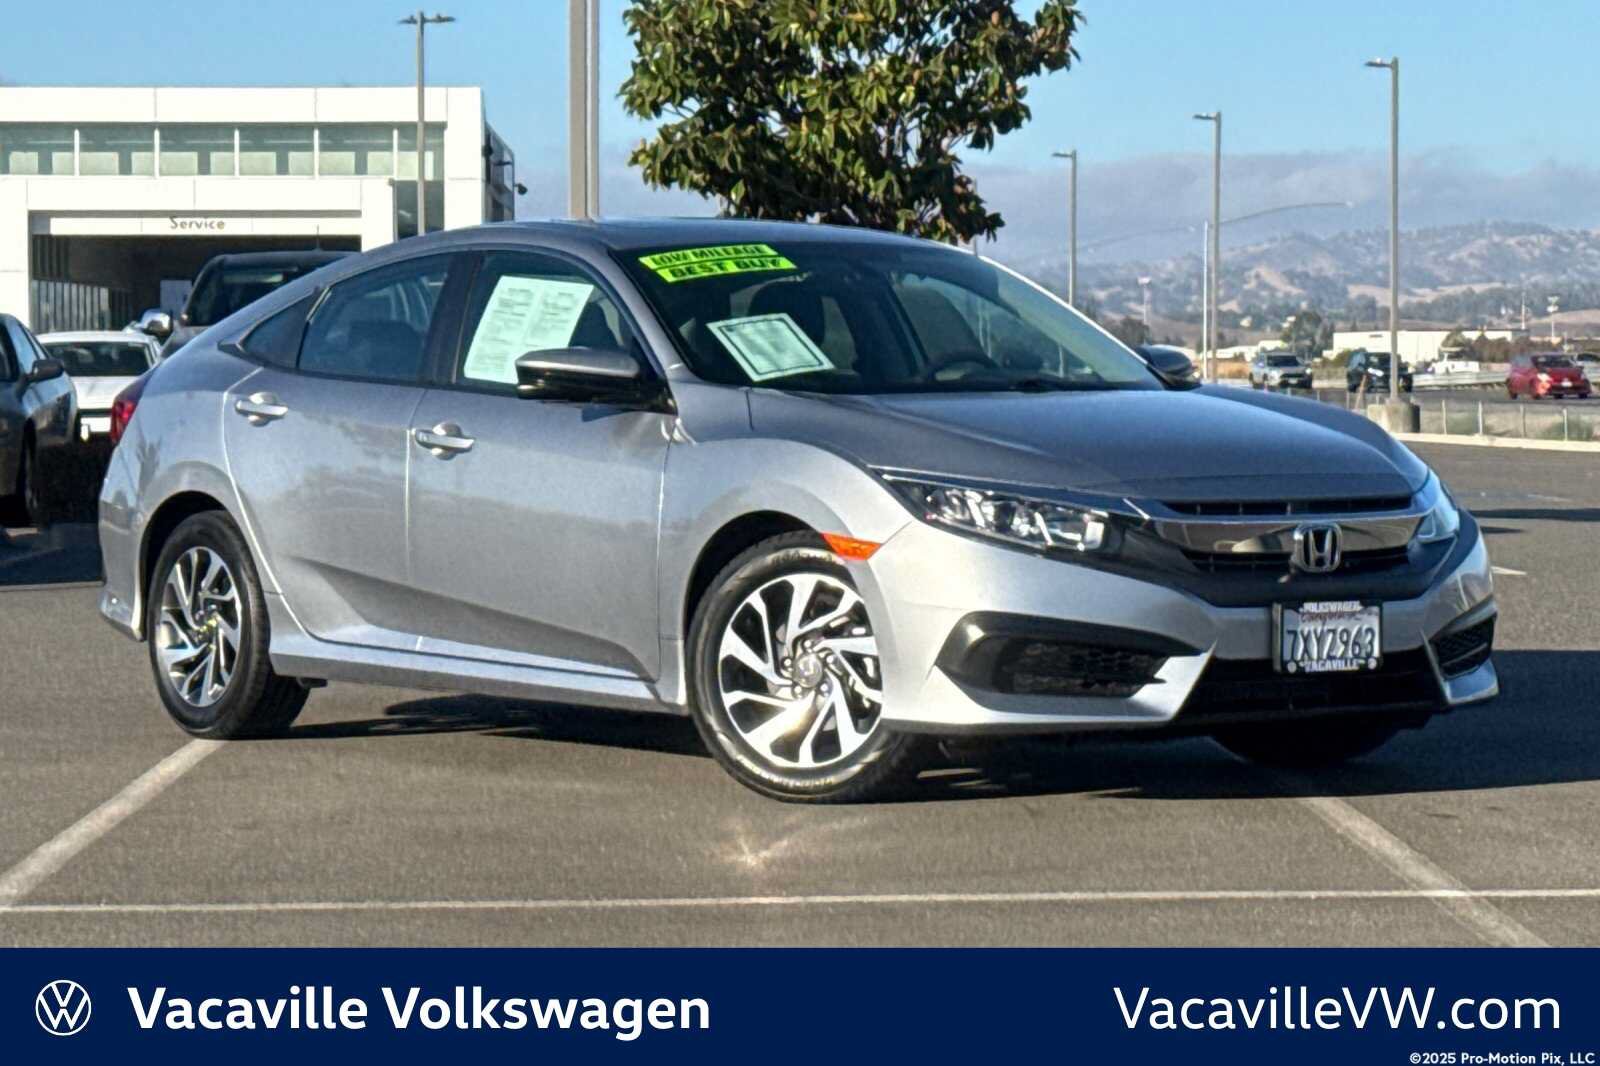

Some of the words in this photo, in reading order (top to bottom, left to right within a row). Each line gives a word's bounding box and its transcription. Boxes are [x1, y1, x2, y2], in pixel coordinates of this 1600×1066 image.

[169, 215, 225, 230] Service
[650, 252, 688, 266] LOW
[691, 246, 767, 260] MILEAGE
[668, 260, 729, 278] BEST
[733, 256, 781, 270] BUY
[1286, 626, 1376, 660] 7XYZ963
[1304, 657, 1361, 673] VACAVILLE
